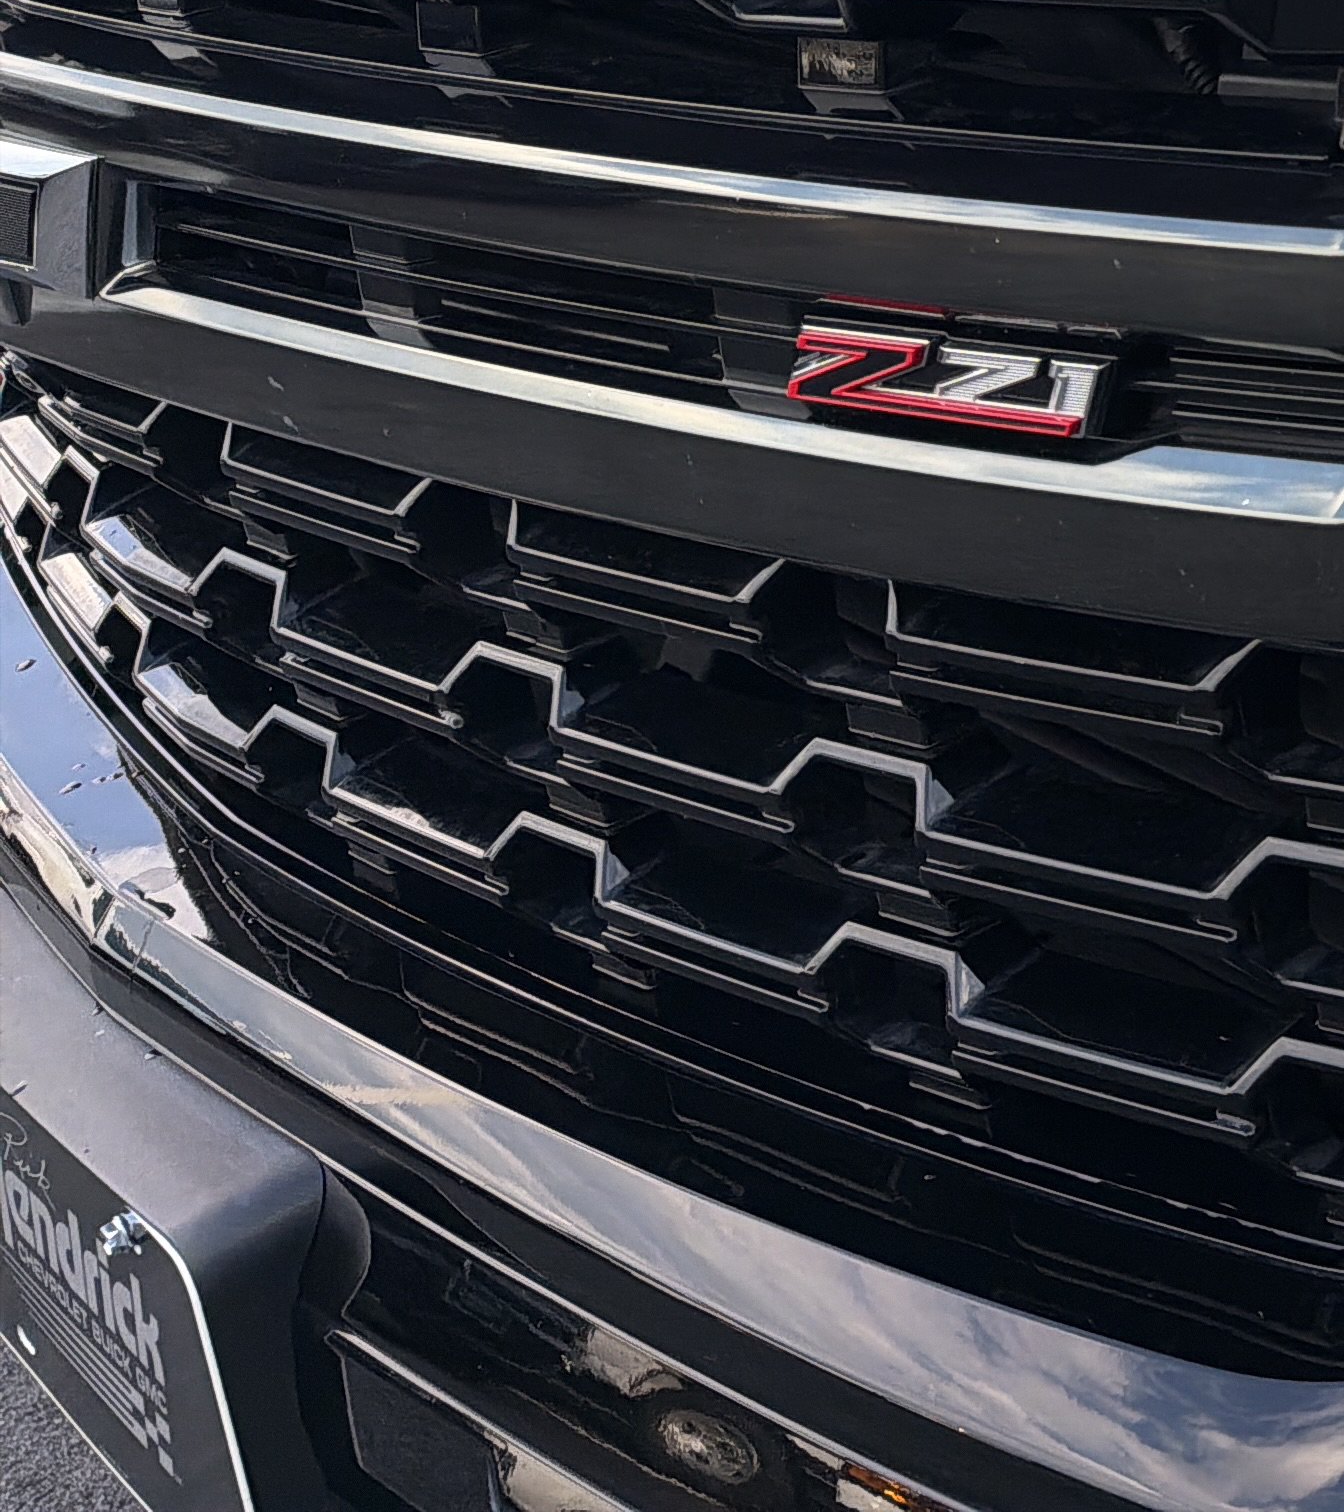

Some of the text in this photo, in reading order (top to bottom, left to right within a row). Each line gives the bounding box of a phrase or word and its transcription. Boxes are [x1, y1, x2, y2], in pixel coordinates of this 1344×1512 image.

[787, 326, 1113, 438] Z71
[17, 1240, 168, 1416] CHEVROLET BUICK GMC
